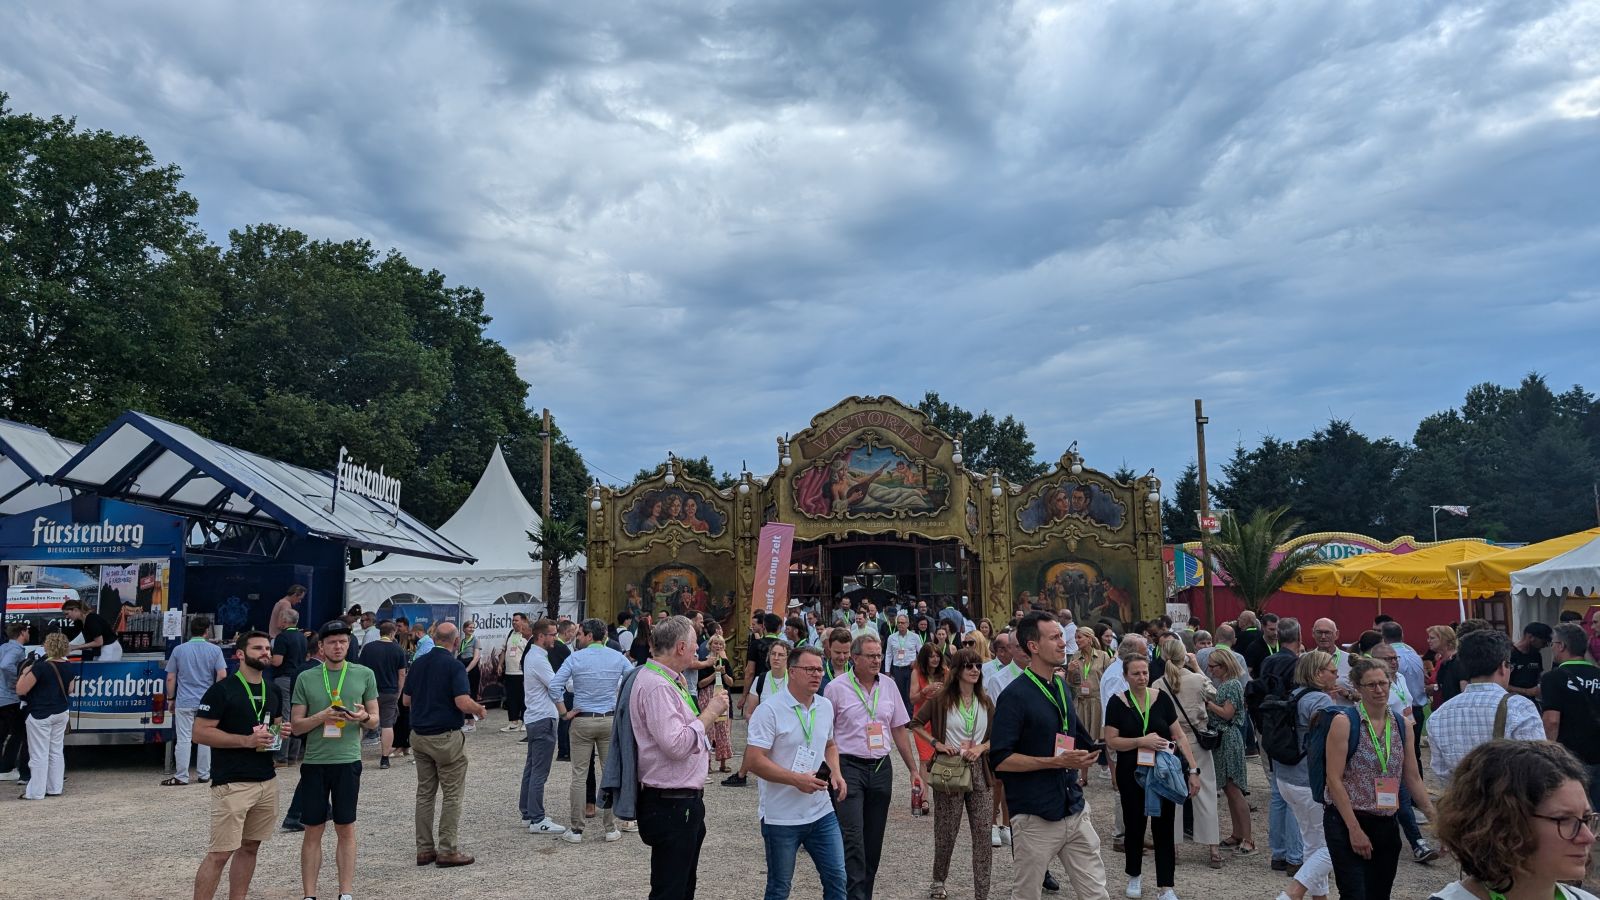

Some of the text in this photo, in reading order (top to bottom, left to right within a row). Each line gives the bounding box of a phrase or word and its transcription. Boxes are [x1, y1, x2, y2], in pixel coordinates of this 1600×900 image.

[812, 410, 923, 450] VICTORIA
[337, 445, 401, 514] Fürstenberg
[32, 516, 144, 548] Fürstenberg
[772, 535, 782, 554] Zelt
[768, 557, 780, 586] Group
[472, 612, 512, 629] Badisch
[68, 672, 164, 697] ürstenberg
